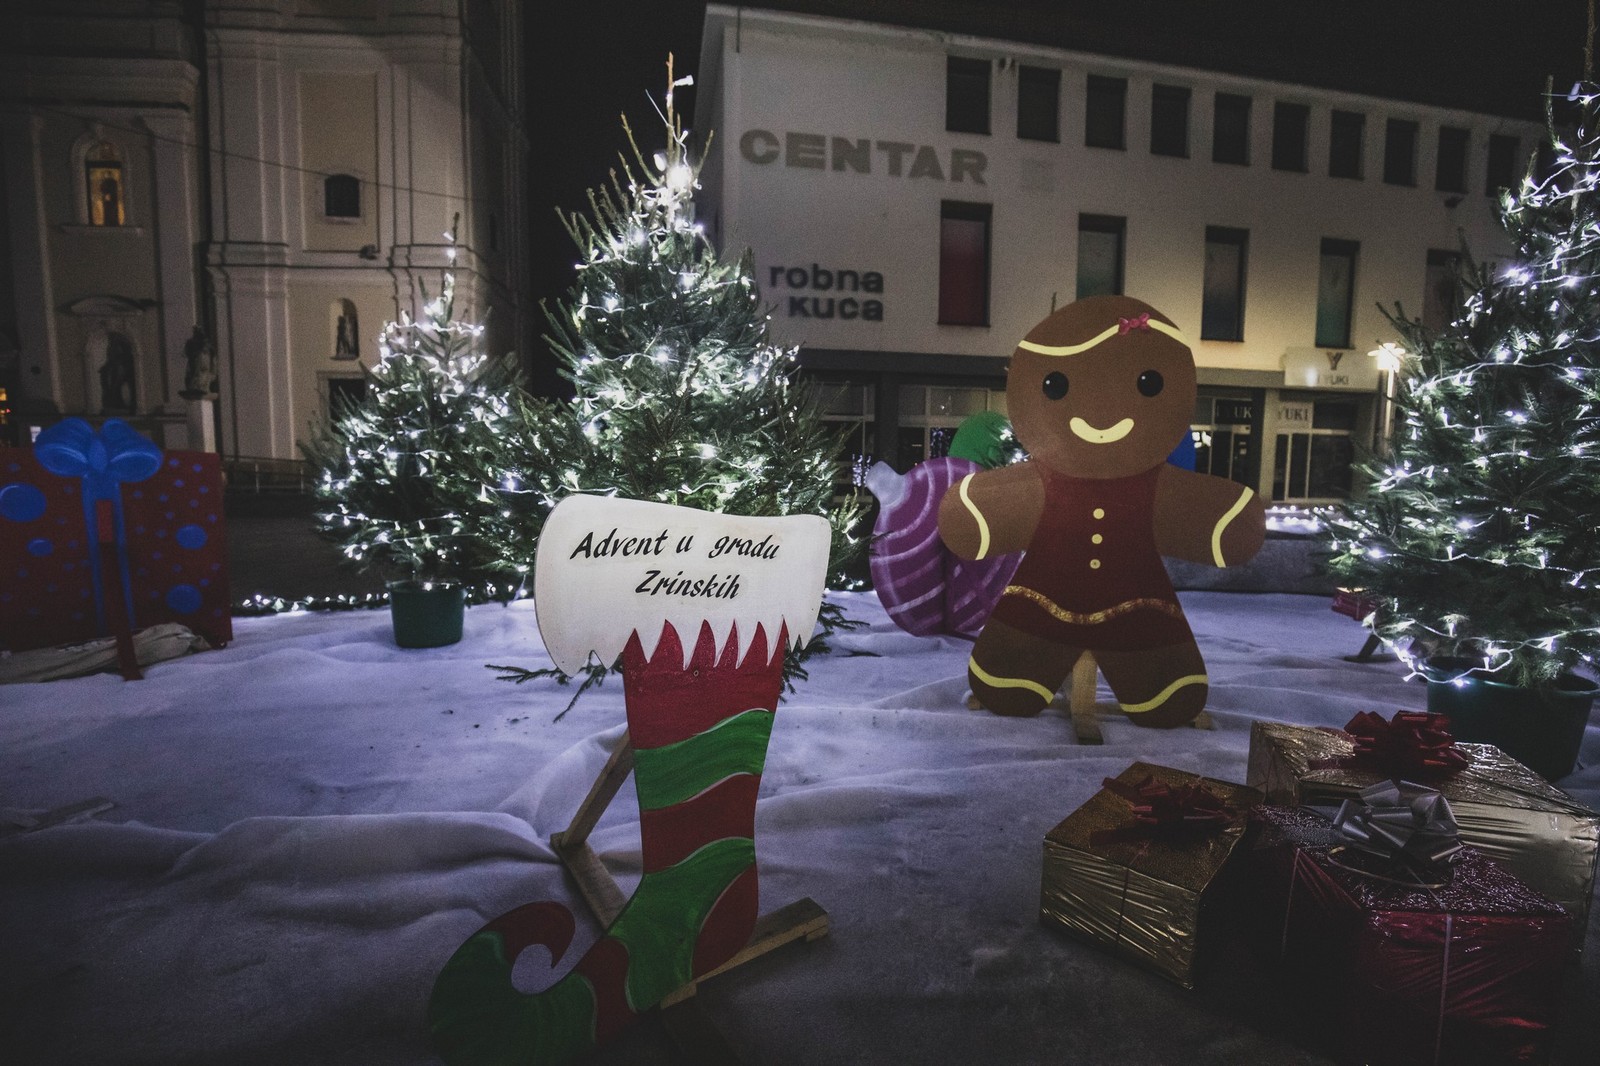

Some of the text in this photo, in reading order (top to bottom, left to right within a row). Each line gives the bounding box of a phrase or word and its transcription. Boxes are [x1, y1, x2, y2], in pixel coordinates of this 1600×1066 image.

[740, 129, 988, 185] CENTAR
[769, 263, 884, 294] robna
[1326, 352, 1343, 371] Y
[570, 528, 780, 560] Advent u gradu
[635, 570, 739, 599] Zrinskih
